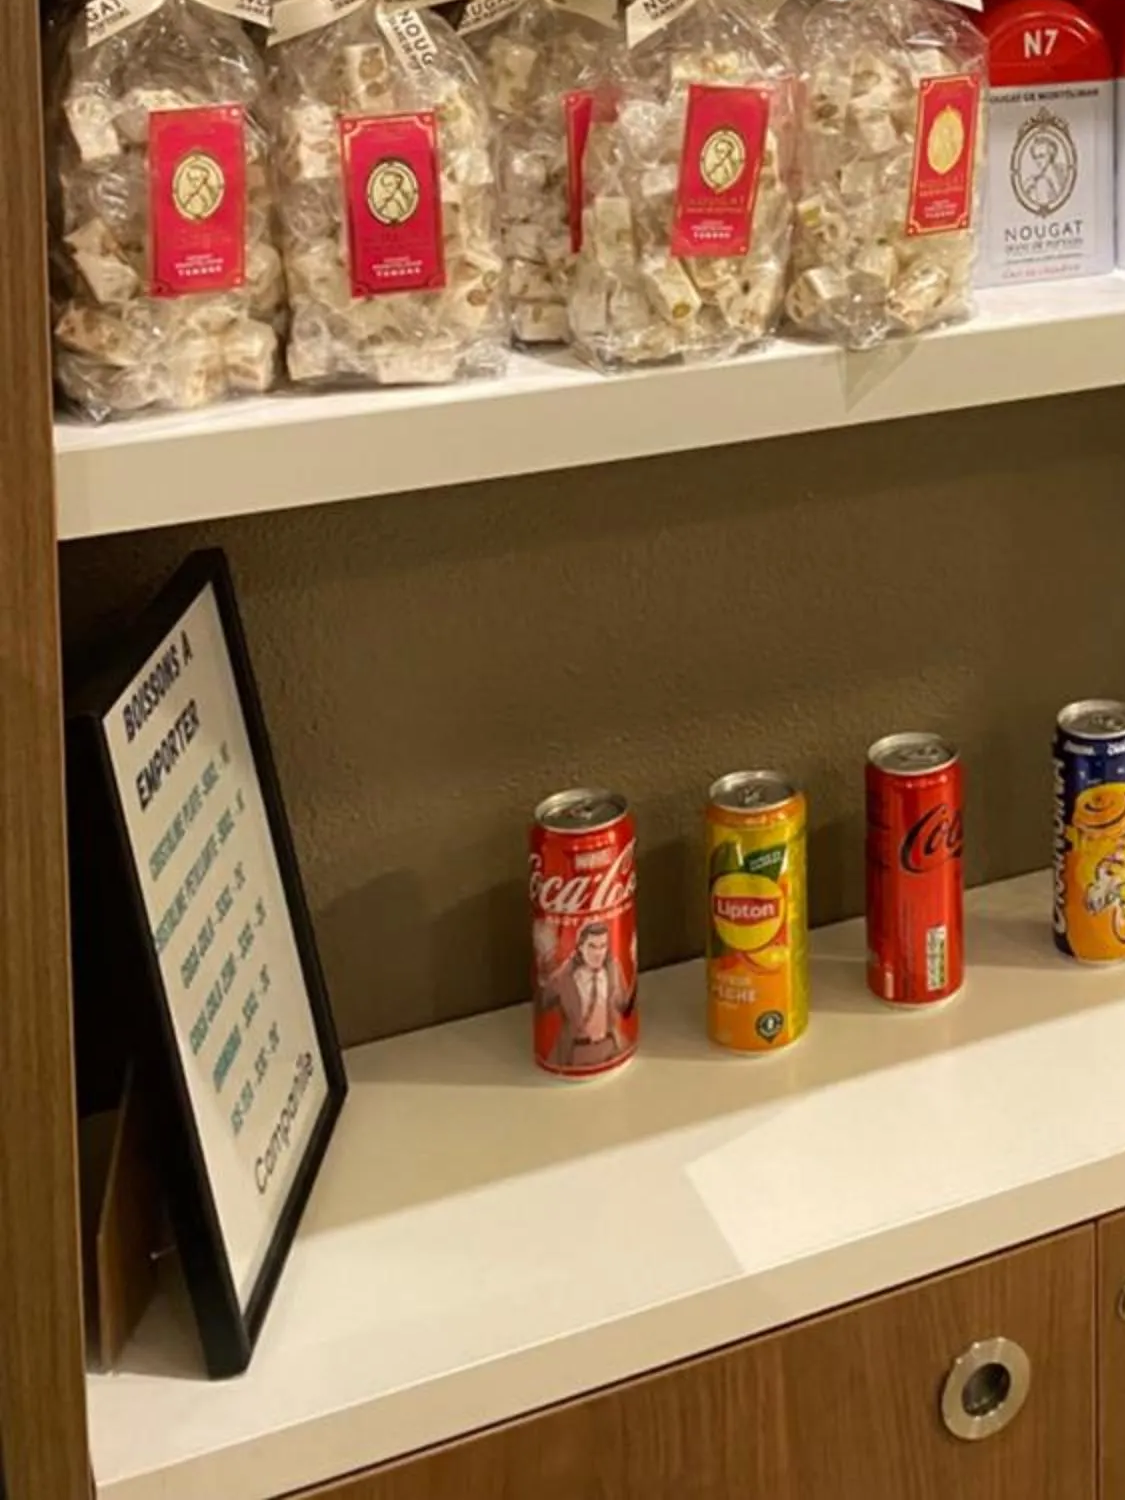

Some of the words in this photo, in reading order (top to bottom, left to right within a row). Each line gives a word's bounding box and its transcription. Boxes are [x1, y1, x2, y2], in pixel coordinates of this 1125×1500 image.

[1023, 29, 1059, 58] N7
[1004, 220, 1083, 242] NOUGAT
[121, 642, 181, 744] BOISSONS
[180, 629, 195, 666] A
[136, 699, 201, 813] EMPORTER
[717, 898, 776, 921] Lipton
[253, 1050, 315, 1196] Campanile
